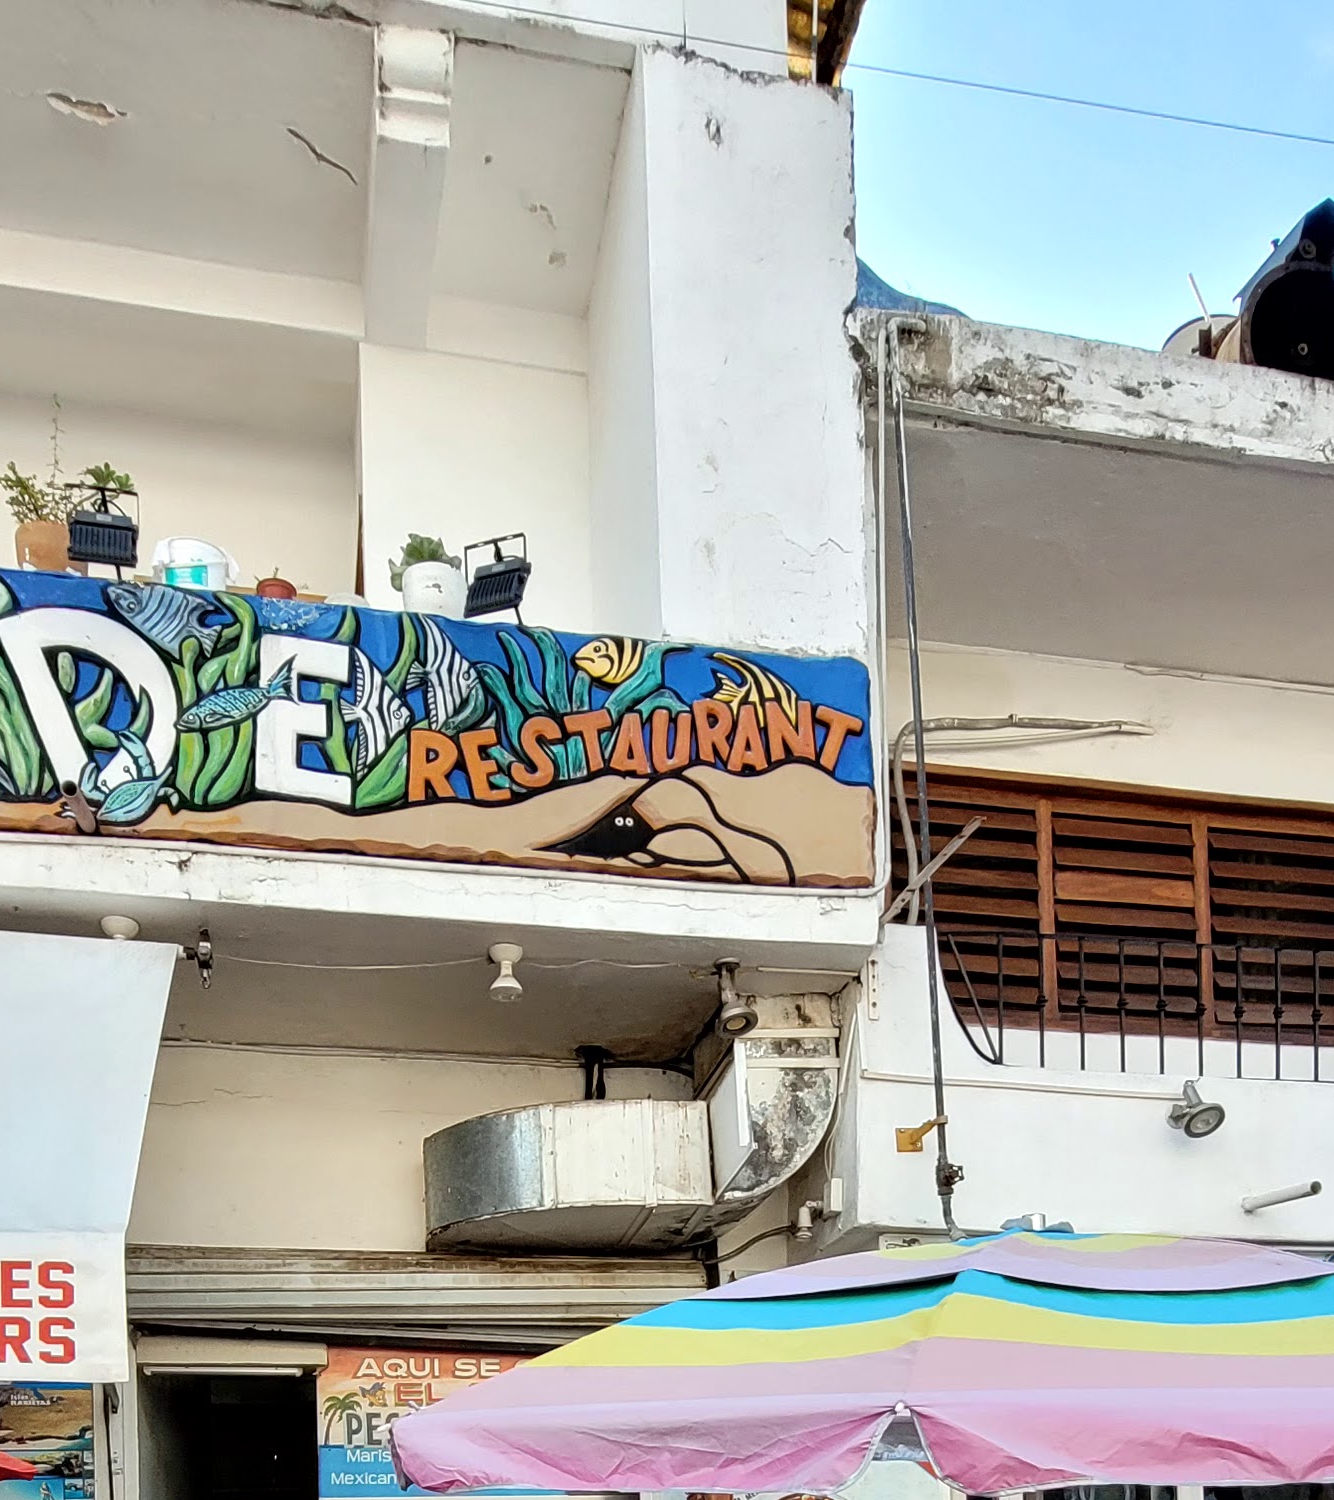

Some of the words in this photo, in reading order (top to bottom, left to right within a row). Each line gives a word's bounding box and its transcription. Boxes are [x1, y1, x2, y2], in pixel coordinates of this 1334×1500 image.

[407, 697, 865, 803] RESTAURANT
[352, 1357, 441, 1379] AQUI
[453, 1358, 501, 1380] SE
[394, 1382, 448, 1407] EL
